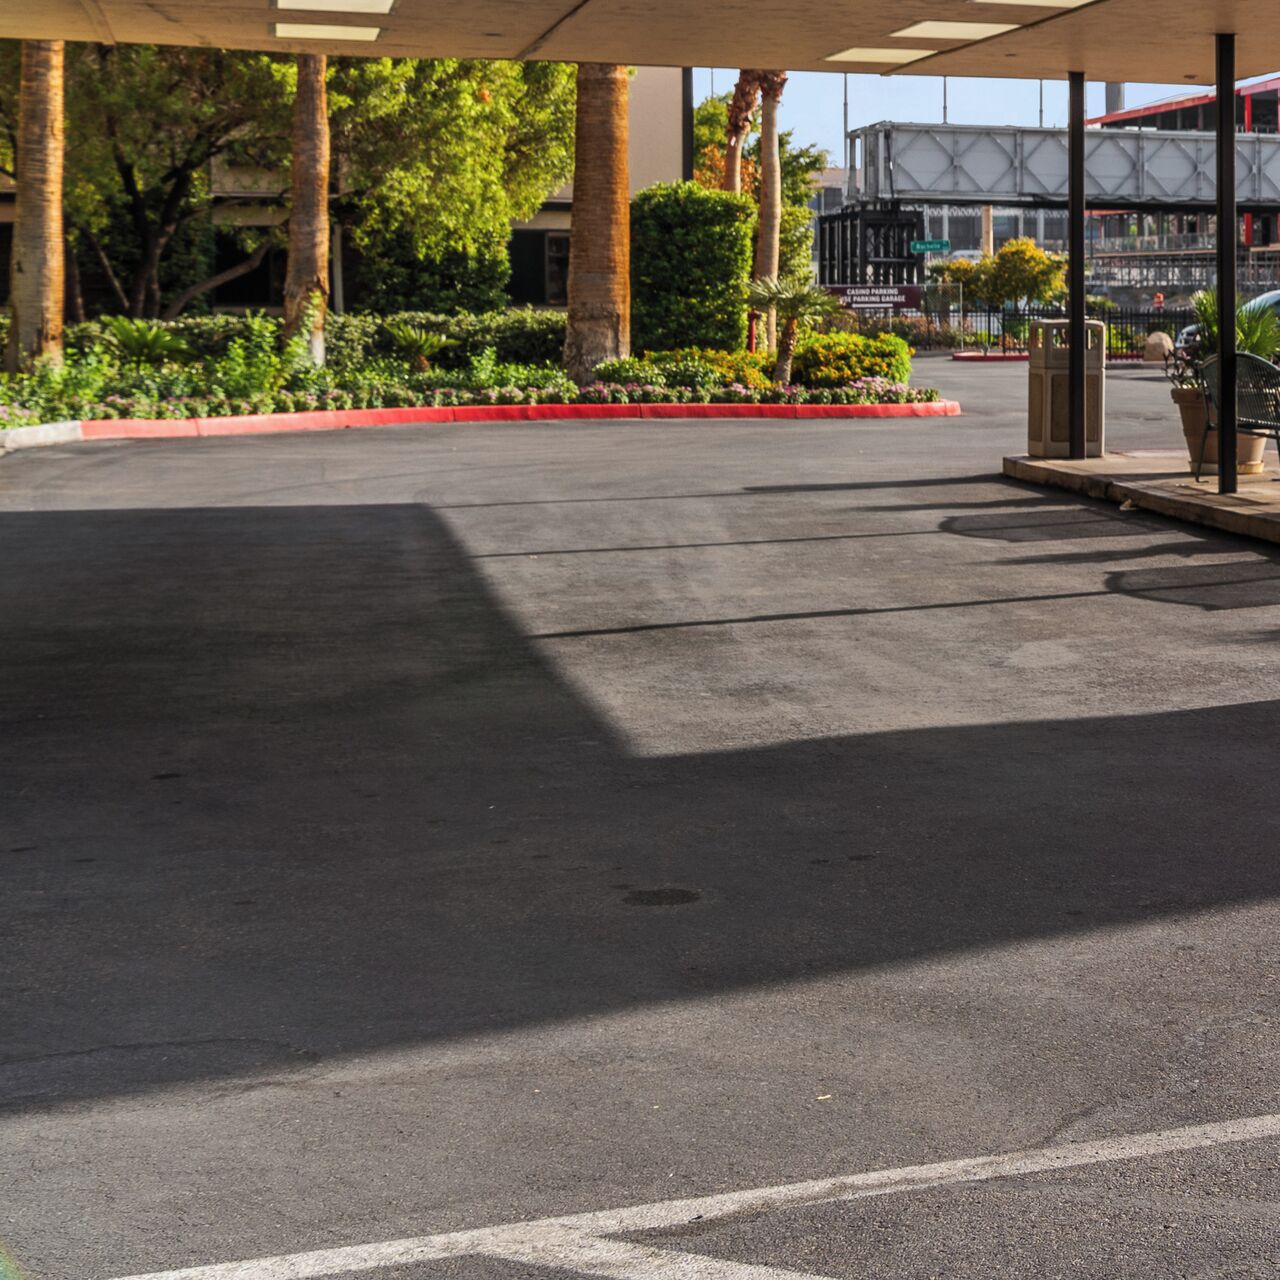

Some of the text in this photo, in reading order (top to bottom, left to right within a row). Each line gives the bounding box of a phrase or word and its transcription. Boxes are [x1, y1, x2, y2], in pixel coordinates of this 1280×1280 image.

[871, 287, 899, 295] PARKING
[853, 295, 880, 303] PARKING
[881, 295, 906, 303] GARAGE
